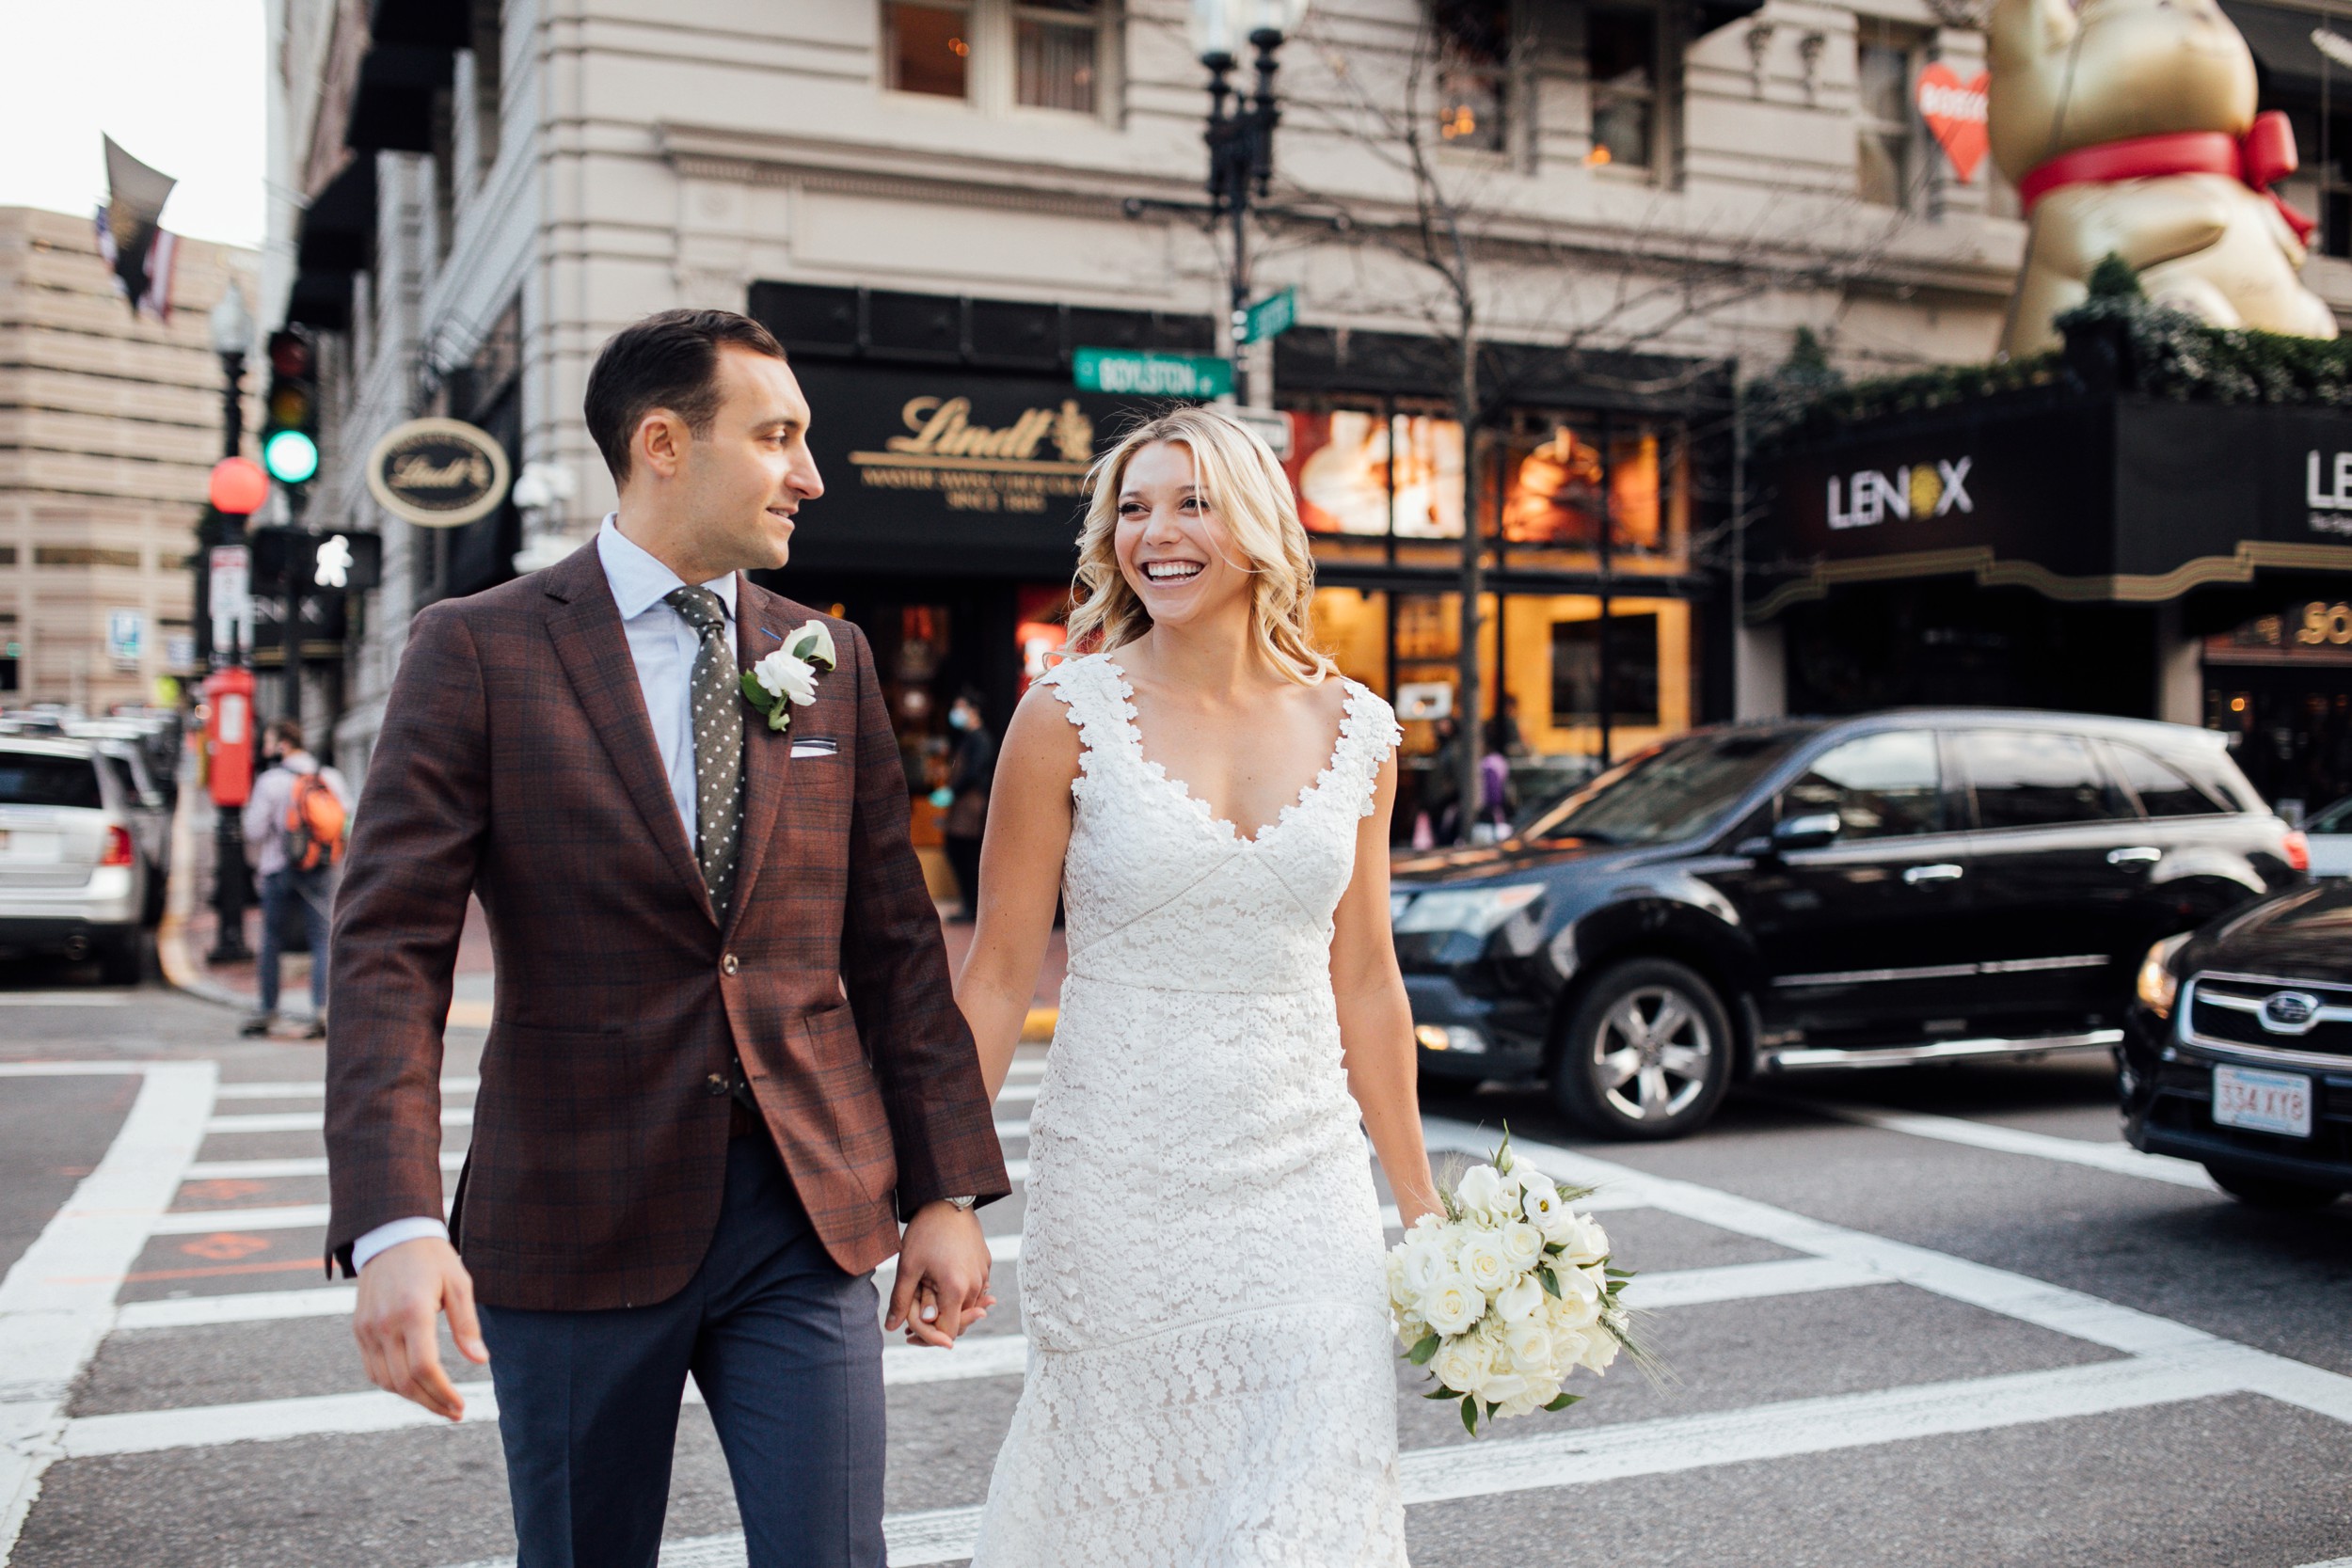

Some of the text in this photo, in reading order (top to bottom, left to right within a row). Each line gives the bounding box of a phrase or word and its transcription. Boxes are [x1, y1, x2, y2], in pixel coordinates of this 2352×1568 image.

[1098, 357, 1197, 394] BOYLSTON
[885, 395, 1056, 459] Lindt
[1827, 454, 1973, 531] LENOX
